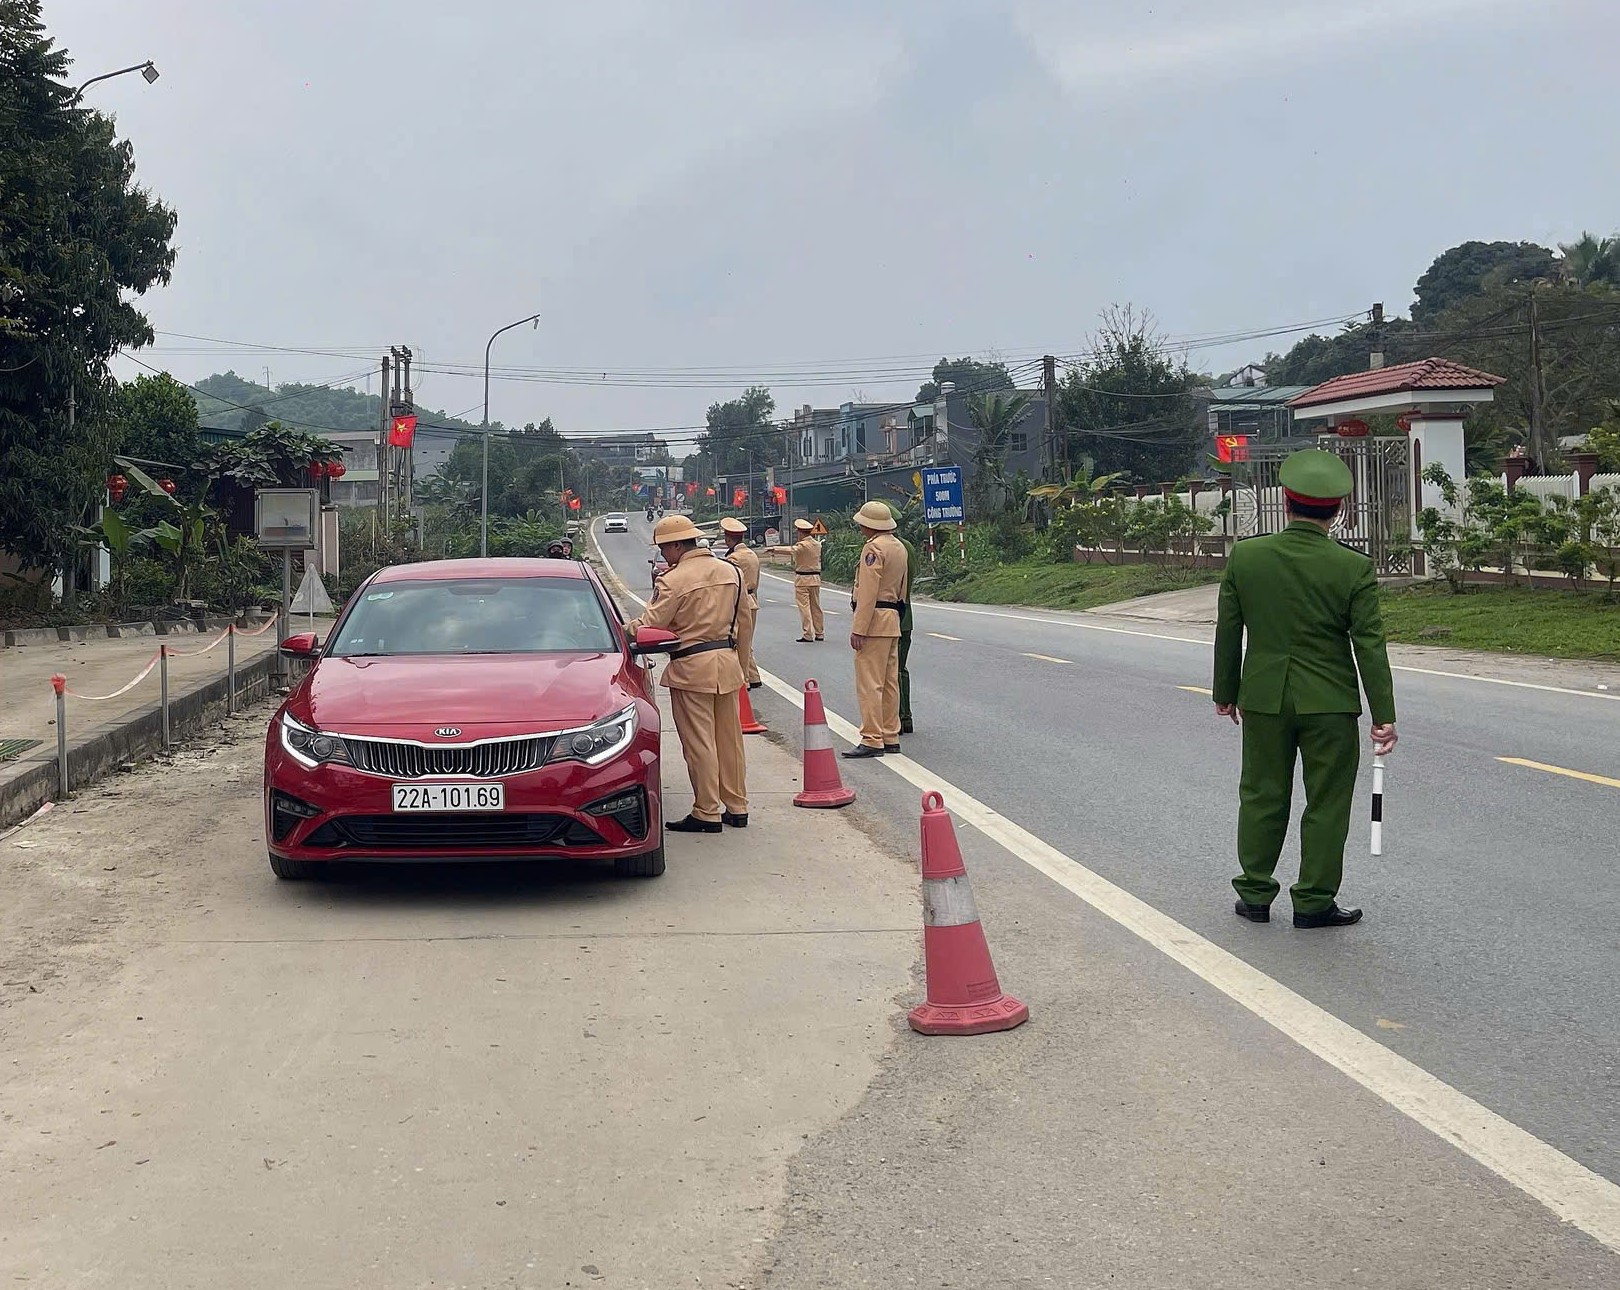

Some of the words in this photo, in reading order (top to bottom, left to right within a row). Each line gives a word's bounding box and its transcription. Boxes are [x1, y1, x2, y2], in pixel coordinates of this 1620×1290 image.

[927, 472, 939, 484] PHÍA
[927, 506, 941, 518] CÔNG
[397, 787, 500, 808] 22A-101.69
